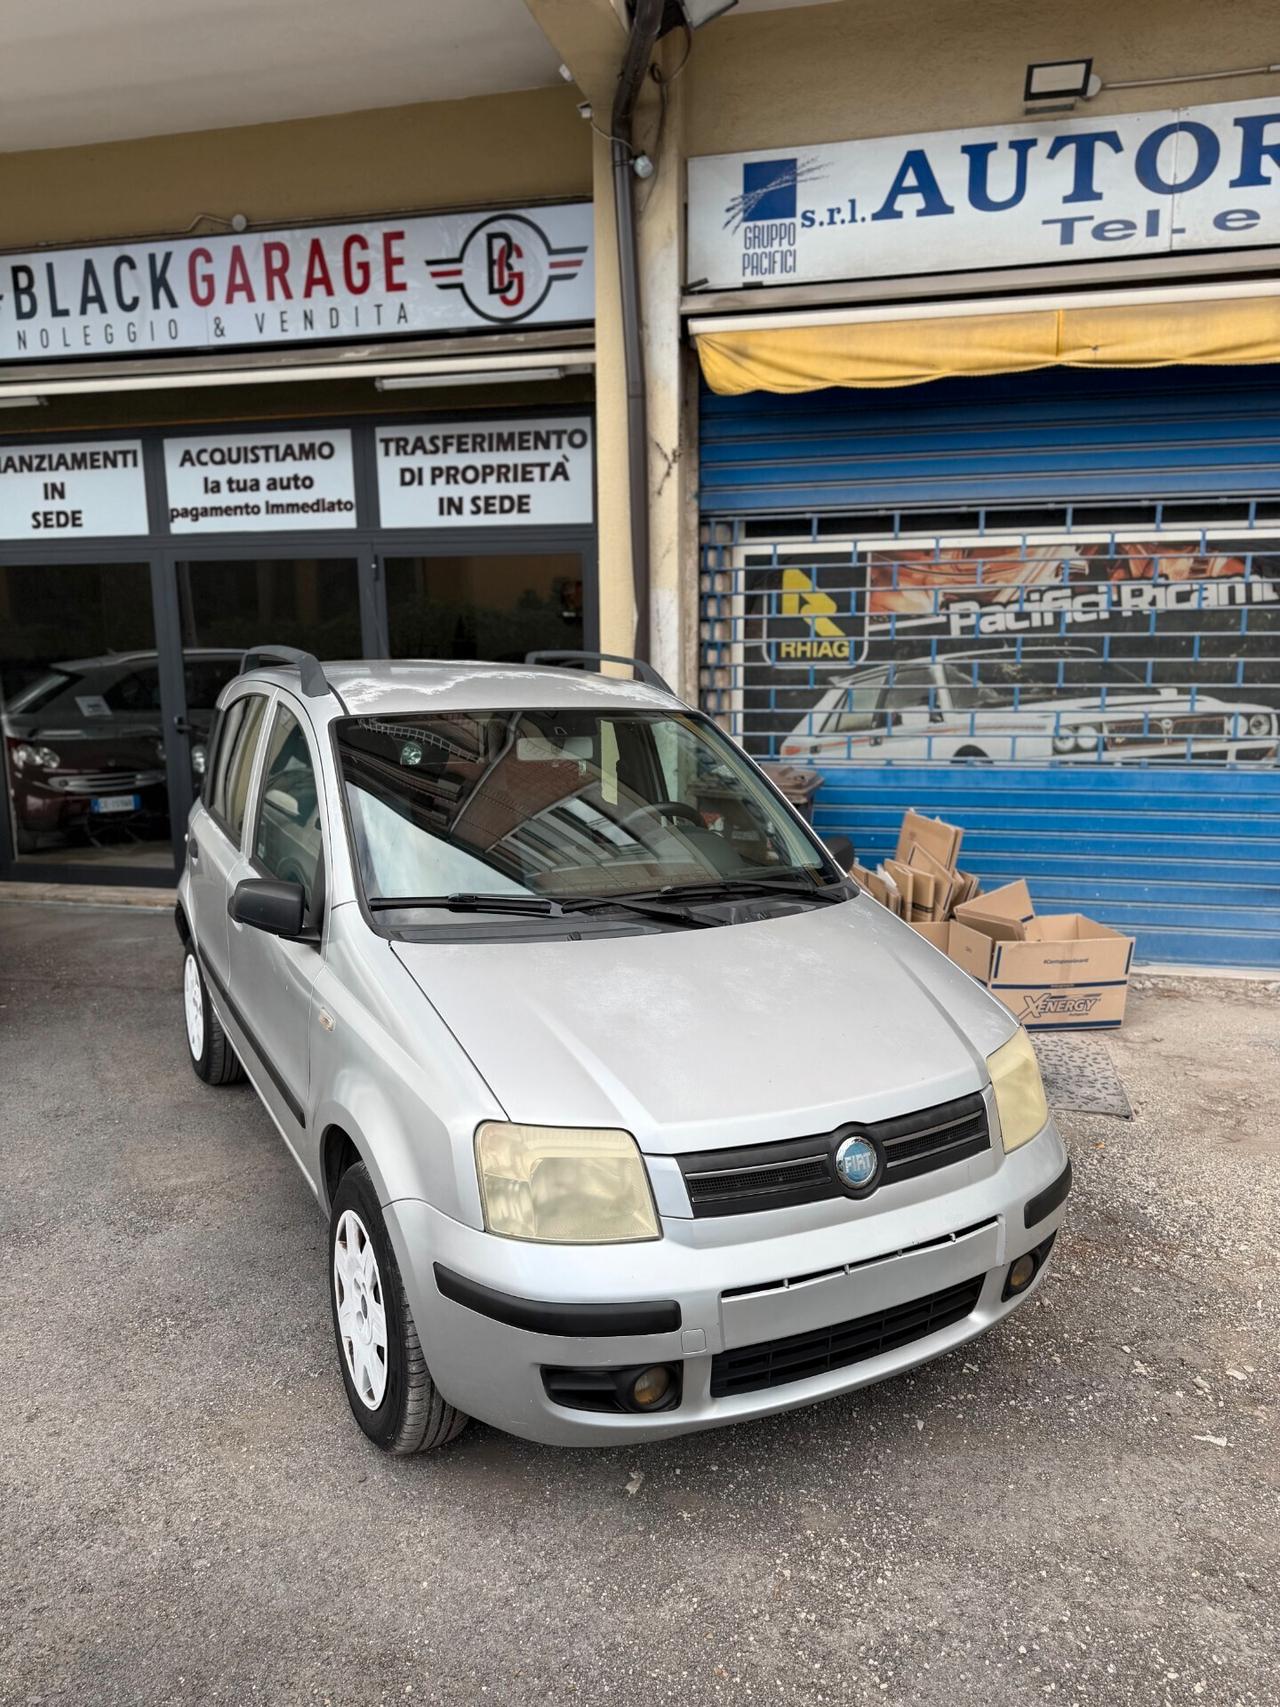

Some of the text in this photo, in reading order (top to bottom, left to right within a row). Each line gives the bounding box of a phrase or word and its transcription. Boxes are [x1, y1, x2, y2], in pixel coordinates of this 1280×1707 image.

[801, 199, 866, 228] s.r.l.
[1213, 208, 1261, 231] e
[744, 222, 796, 250] GRUPPO
[742, 249, 797, 277] PACIFICI
[17, 302, 409, 351] NOLEGGIO & VENDITA
[179, 441, 335, 468] ACQUISTIAMO
[379, 428, 588, 457] TRASFERIMENTO
[0, 449, 138, 474] ANZIAMENTI
[400, 454, 570, 486] DI PROPRIETÀ
[43, 482, 66, 500] IN
[204, 473, 314, 494] la tua auto
[169, 501, 261, 523] pagamento
[438, 494, 531, 516] IN SEDE
[31, 510, 83, 529] SEDE
[950, 585, 1110, 637] Pacifici
[781, 641, 849, 658] RHIAG
[844, 1152, 871, 1173] FIAT
